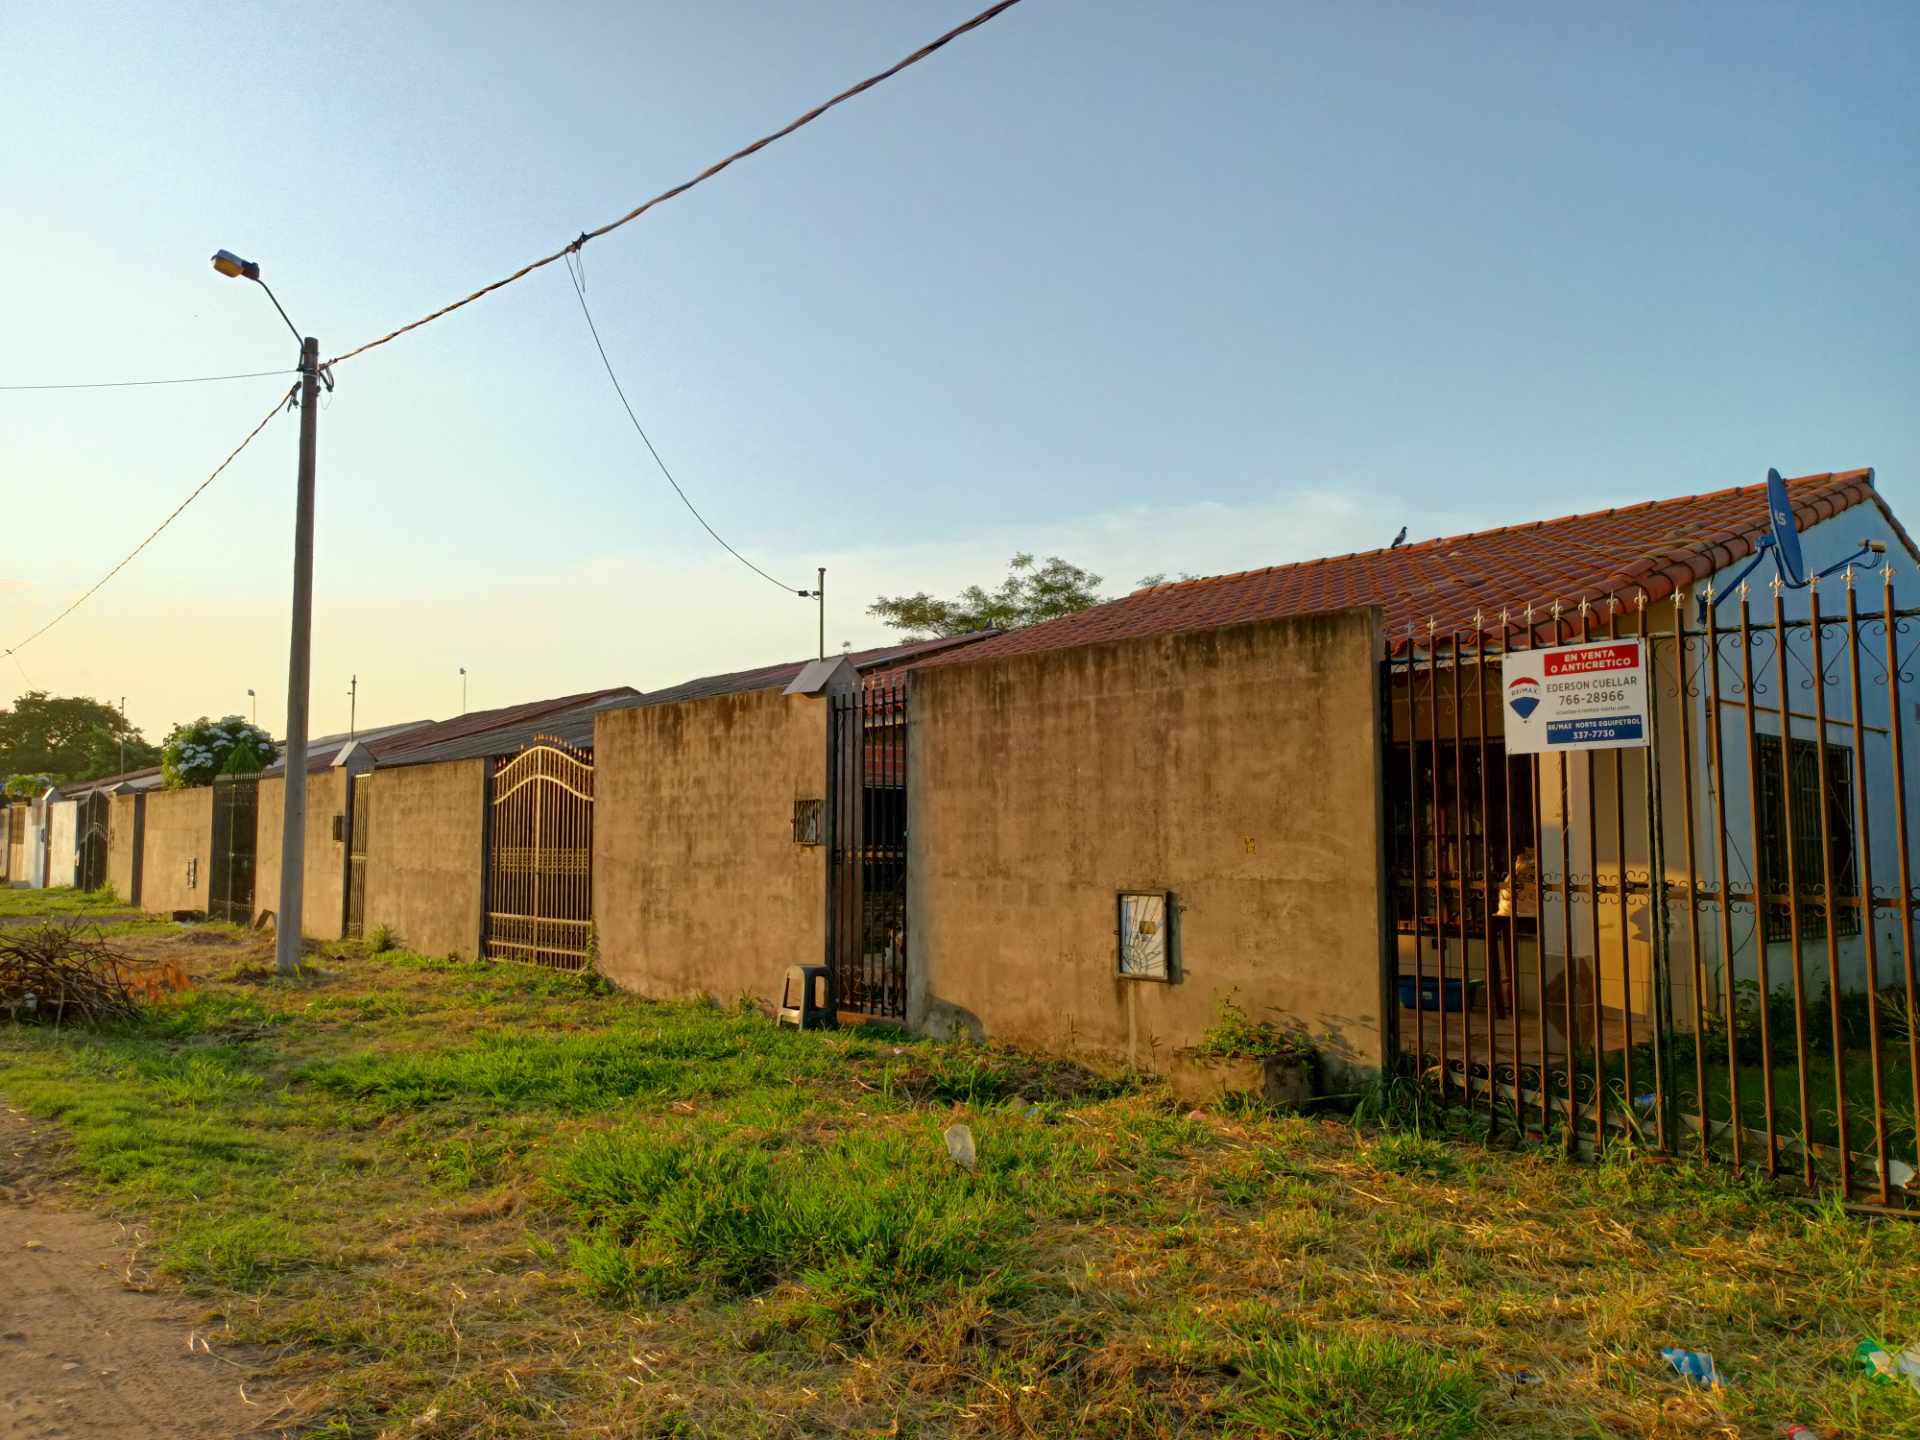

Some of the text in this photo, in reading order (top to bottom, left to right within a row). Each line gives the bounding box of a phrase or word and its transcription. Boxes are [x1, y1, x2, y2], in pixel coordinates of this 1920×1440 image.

[1564, 649, 1615, 662] EN VENTA
[1550, 665, 1558, 673] O
[1546, 676, 1637, 693] EDERSON CUELLAR
[1559, 690, 1624, 706] 766-28966
